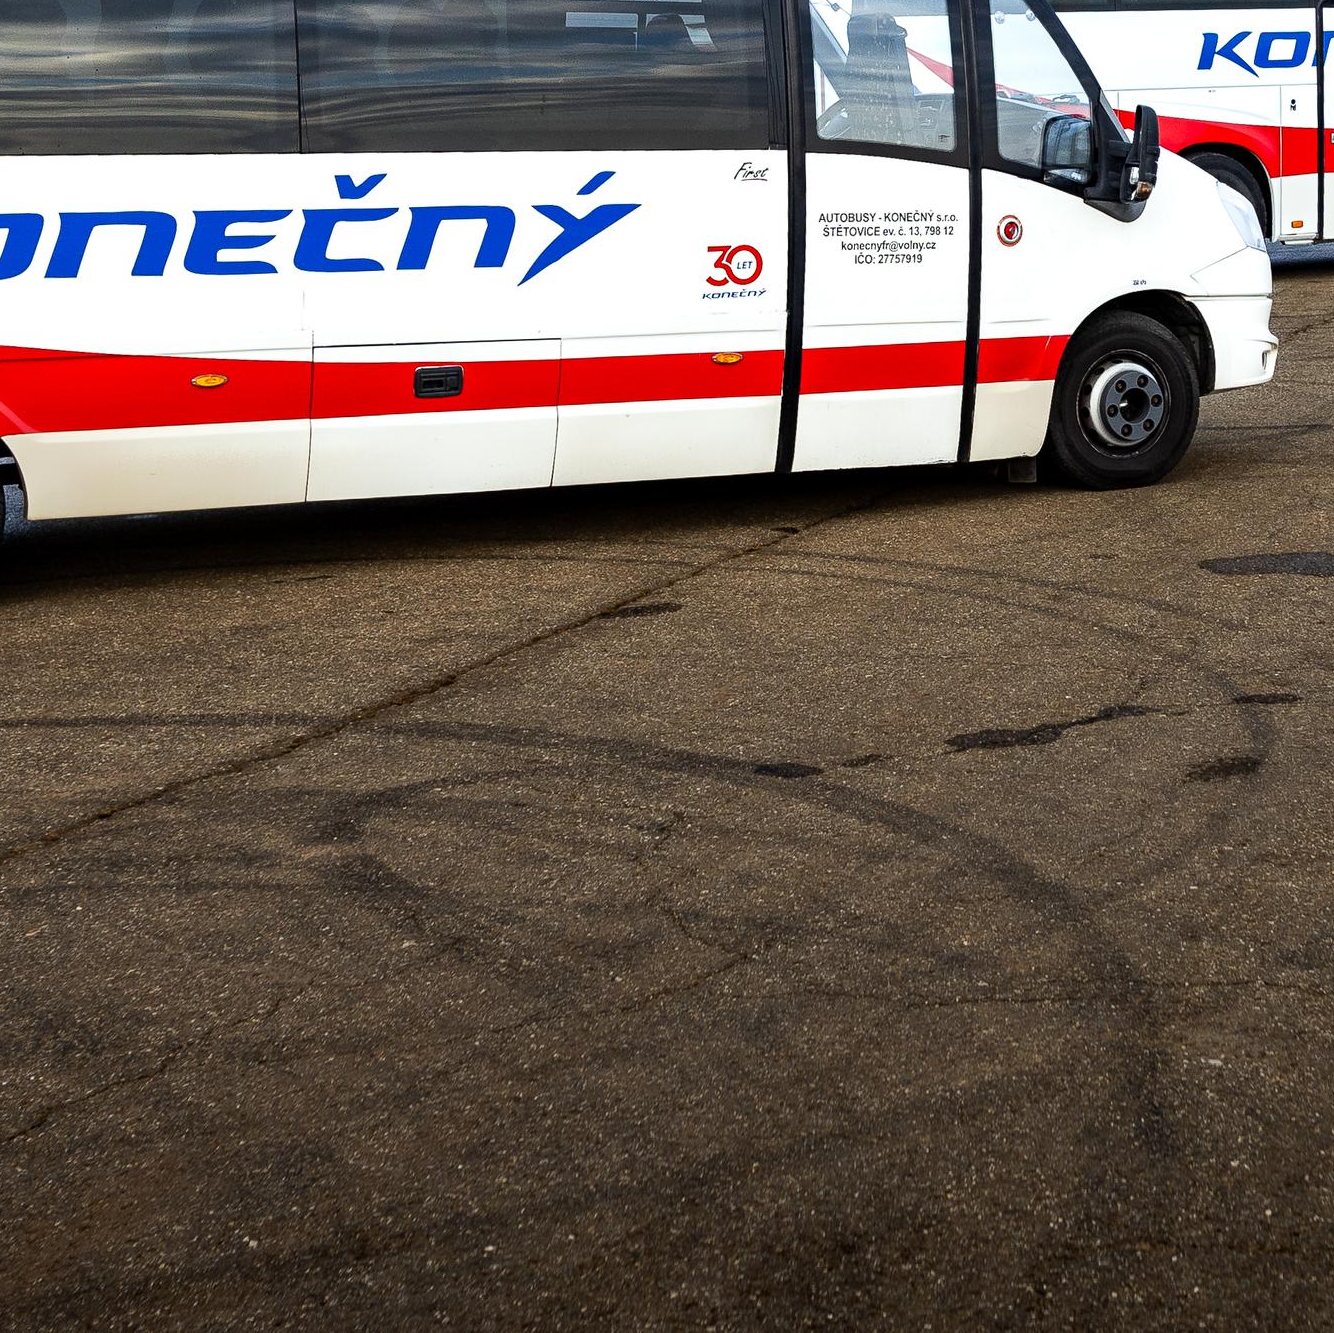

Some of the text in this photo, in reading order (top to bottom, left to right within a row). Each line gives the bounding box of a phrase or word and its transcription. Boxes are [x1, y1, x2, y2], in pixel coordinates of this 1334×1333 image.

[733, 161, 769, 181] First
[818, 212, 876, 223] AUTOBUSY
[883, 209, 934, 222] KONEČNÝ
[936, 213, 959, 222] s.r.o.
[822, 224, 880, 237] ŠTĚTOVICE
[882, 227, 896, 236] ev.
[898, 226, 907, 236] č.
[924, 225, 941, 236] 798
[944, 225, 954, 235] 12
[841, 240, 936, 252] konecnyfr@volny.cz
[854, 252, 923, 264] IČO: 27757919
[706, 244, 763, 287] 30
[736, 261, 753, 270] LET
